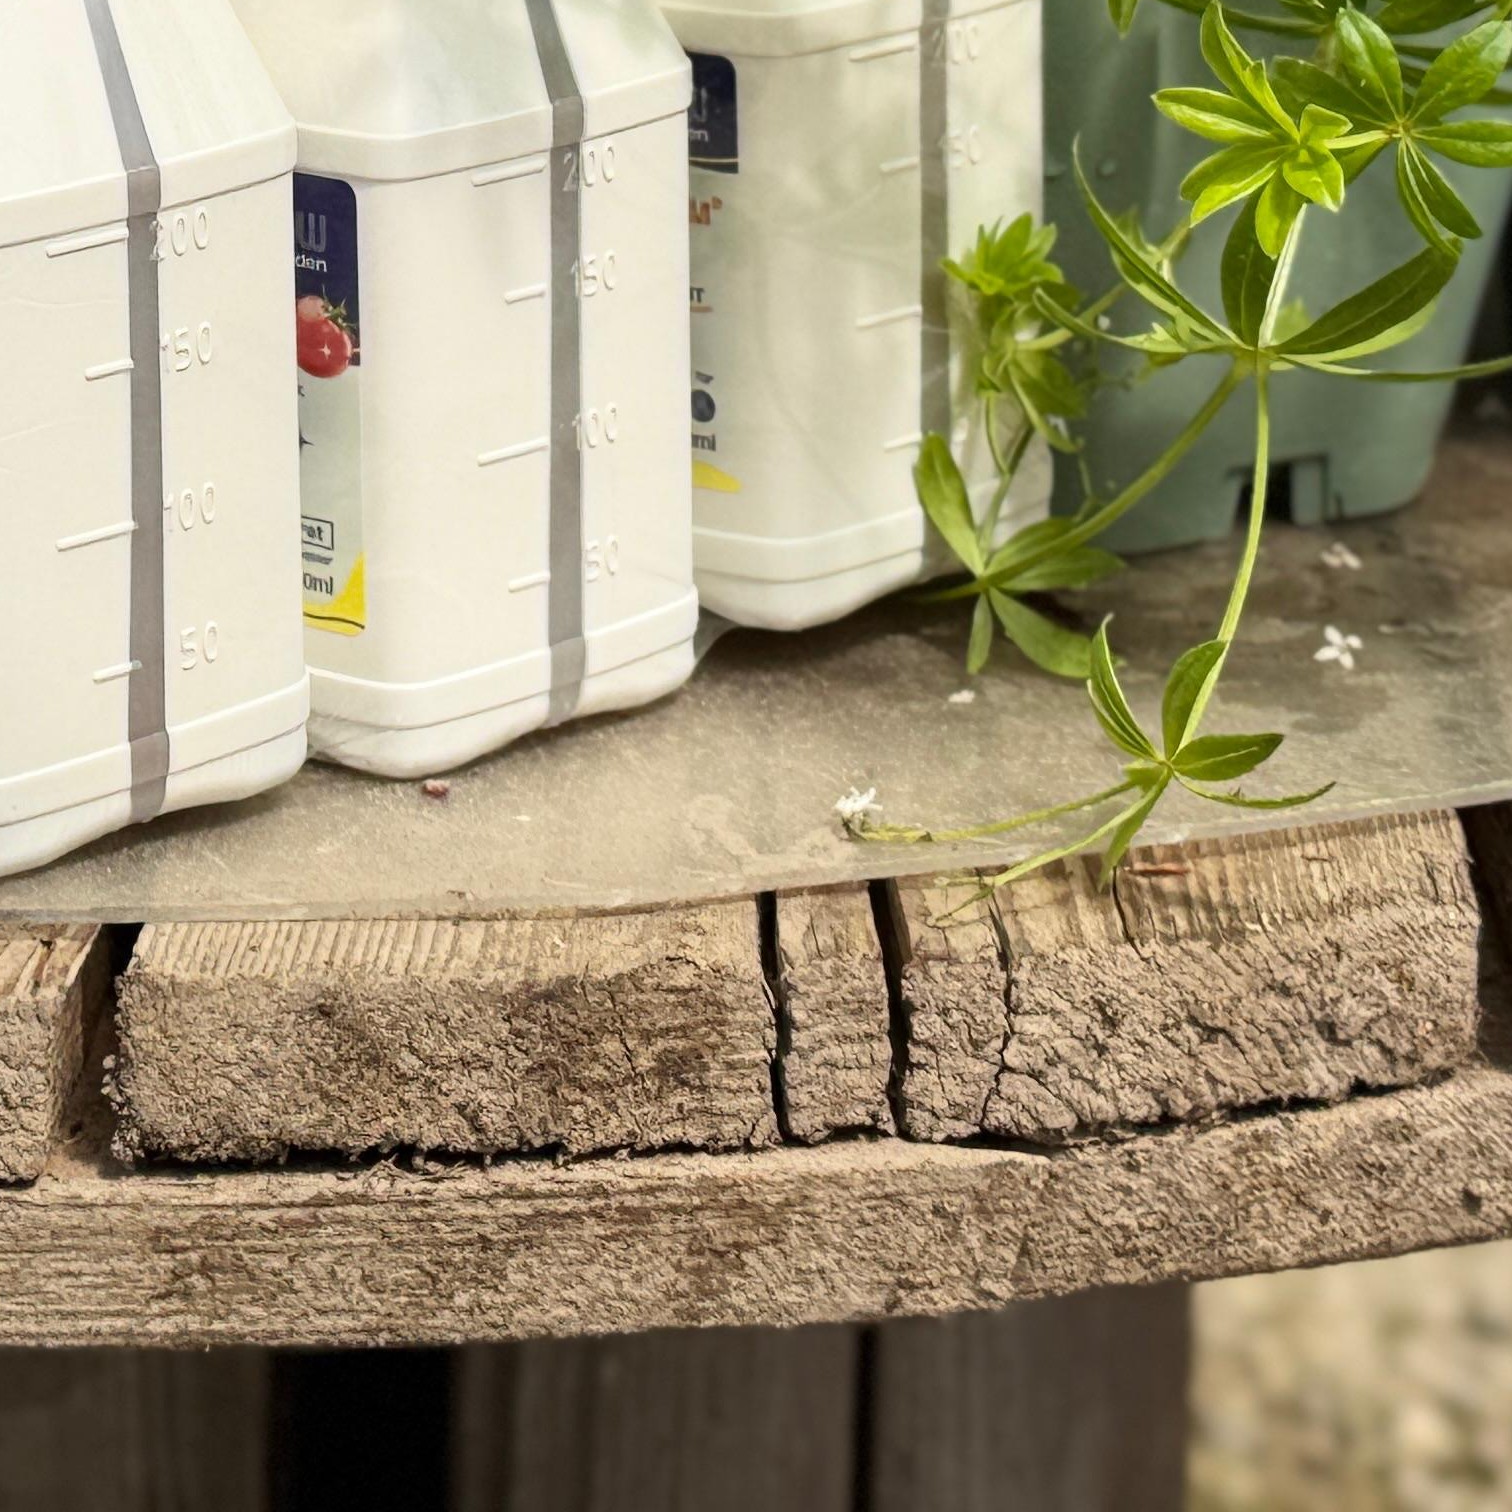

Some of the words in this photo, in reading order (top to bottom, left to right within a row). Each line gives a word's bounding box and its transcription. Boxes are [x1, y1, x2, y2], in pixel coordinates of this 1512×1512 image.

[562, 138, 617, 192] 200
[585, 534, 620, 583] 50
[179, 618, 219, 672] 50
